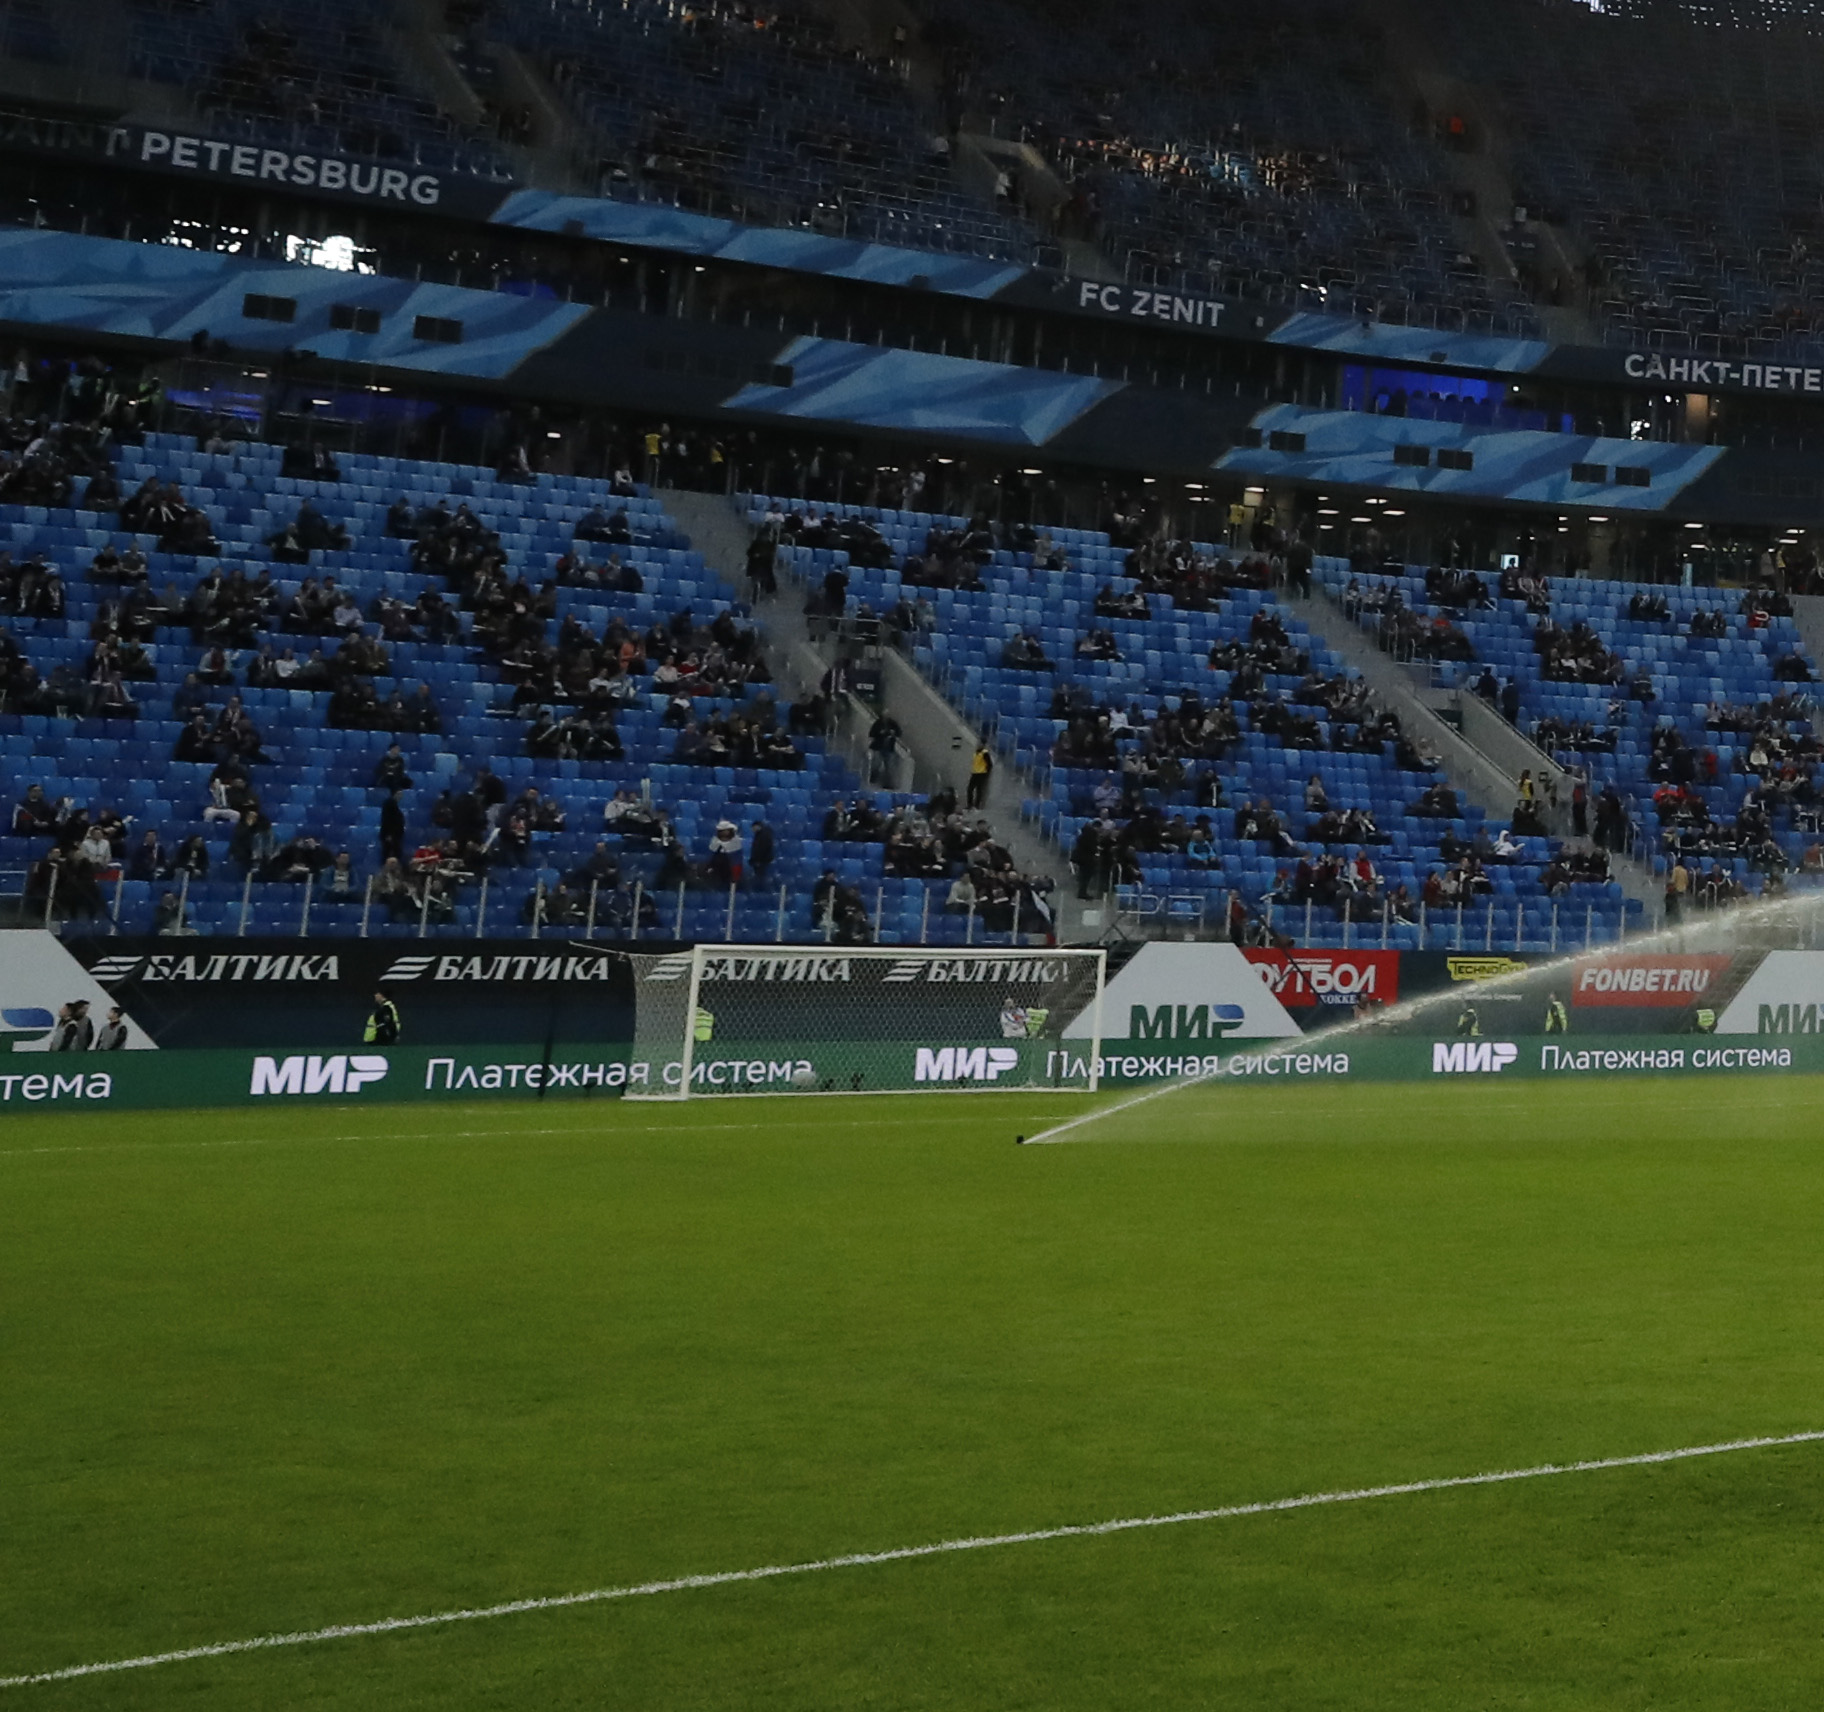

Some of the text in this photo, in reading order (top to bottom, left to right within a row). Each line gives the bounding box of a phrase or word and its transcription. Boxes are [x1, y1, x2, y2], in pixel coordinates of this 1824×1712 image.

[141, 131, 440, 205] PETERSBURG
[1079, 282, 1225, 327] FC ZENIT
[142, 955, 339, 982] БАЛТИКА
[433, 955, 609, 981] БАЛТИКА
[700, 957, 850, 982] БАЛТИКА
[1579, 967, 1711, 993] FONBET.RU
[1129, 1004, 1245, 1038] МИР
[914, 1047, 1349, 1082] МИР Платежная система
[1432, 1042, 1791, 1073] МИР Платежная система
[250, 1055, 813, 1095] МИР Платежная система
